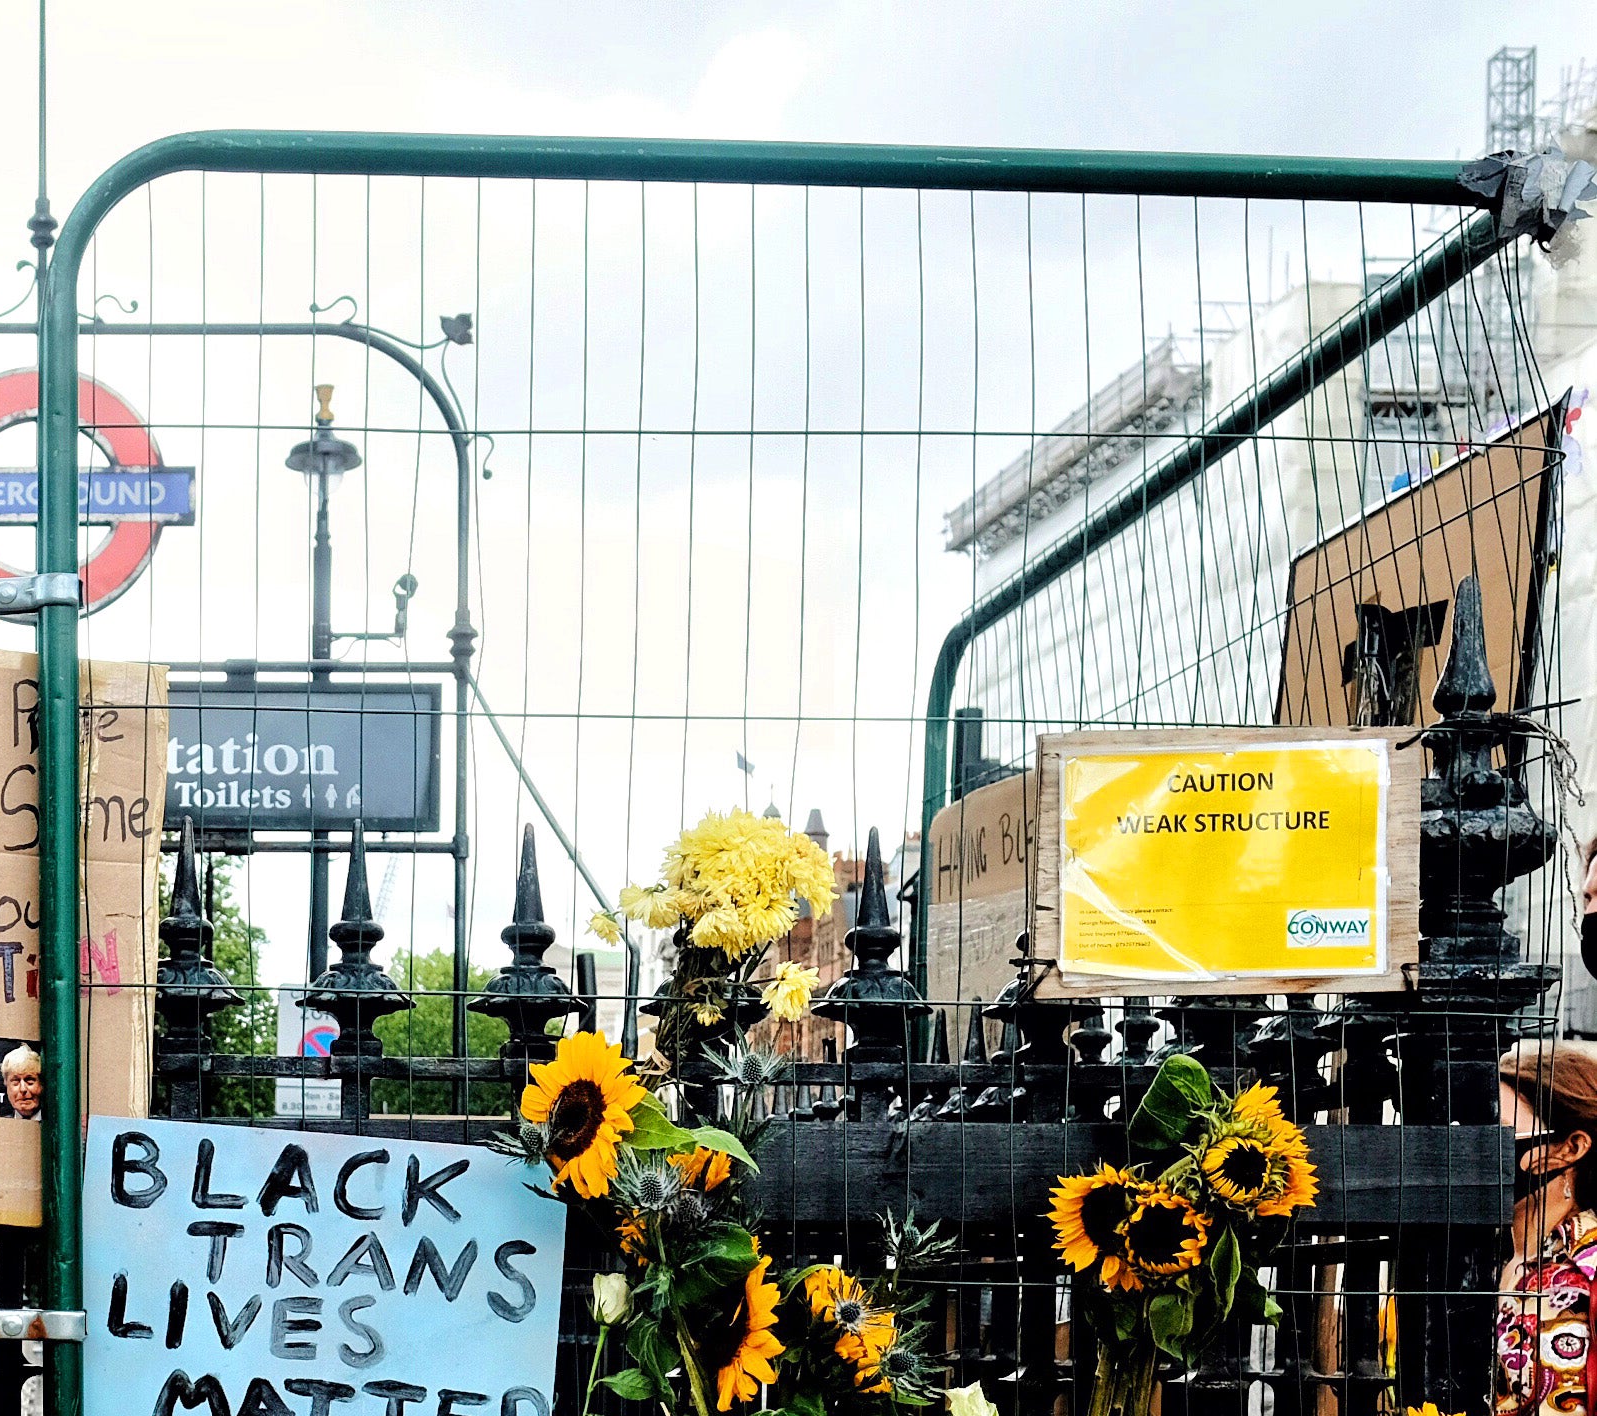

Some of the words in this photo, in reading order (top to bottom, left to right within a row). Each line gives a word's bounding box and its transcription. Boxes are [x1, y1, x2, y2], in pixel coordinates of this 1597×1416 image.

[167, 733, 339, 775] tation
[175, 780, 292, 809] Toilets
[1167, 771, 1274, 794] CAUTION
[1, 764, 155, 851] Sme
[1116, 813, 1188, 835] WEAK
[1194, 810, 1330, 833] STRUCTURE
[1287, 919, 1369, 935] CONWAY
[110, 1131, 470, 1227] BLACK
[186, 1221, 537, 1323] TRANS
[106, 1268, 386, 1370] LIVES
